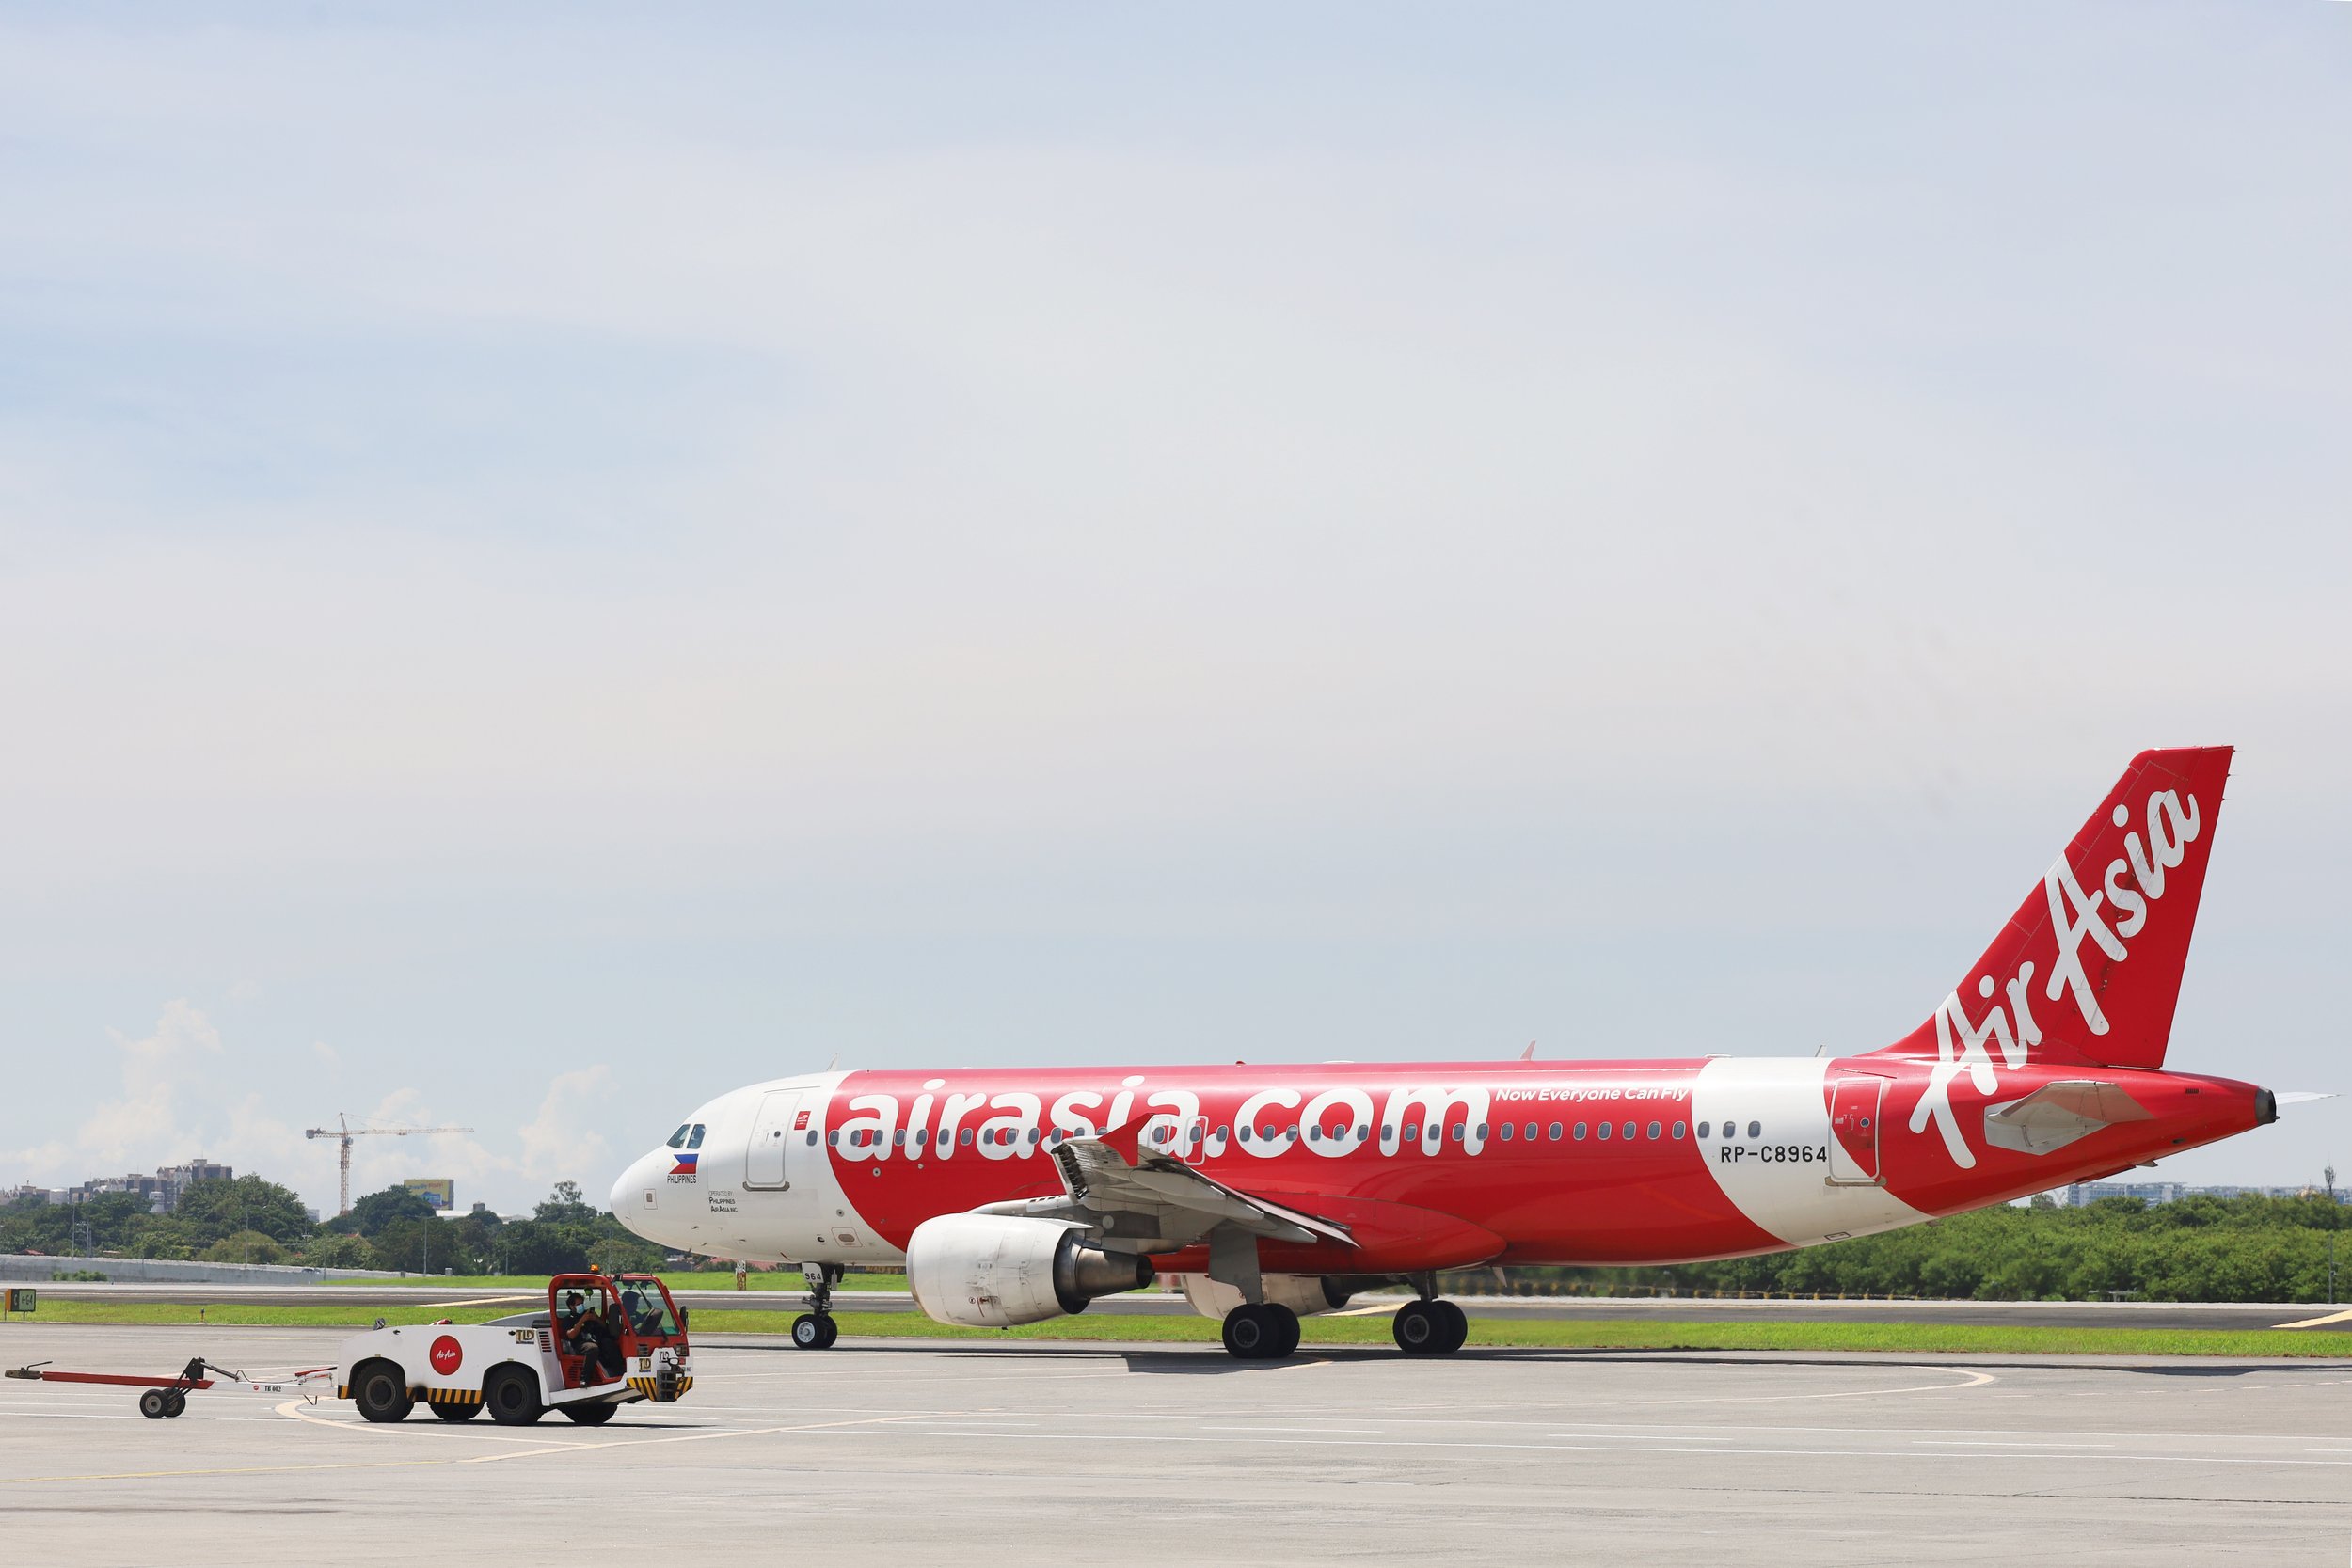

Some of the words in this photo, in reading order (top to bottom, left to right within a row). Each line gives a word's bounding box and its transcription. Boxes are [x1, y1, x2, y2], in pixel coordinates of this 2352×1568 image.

[1495, 1088, 1536, 1101] Now
[1537, 1088, 1621, 1102] Everyone
[1624, 1087, 1658, 1100] Can
[1661, 1086, 1690, 1101] Fly
[834, 1075, 1491, 1162] airasia.com
[1721, 1146, 1827, 1163] RP-C8964
[667, 1175, 696, 1184] PHILIPPINES
[804, 1272, 822, 1281] 964
[516, 1329, 535, 1341] TLD
[638, 1357, 651, 1370] TLD
